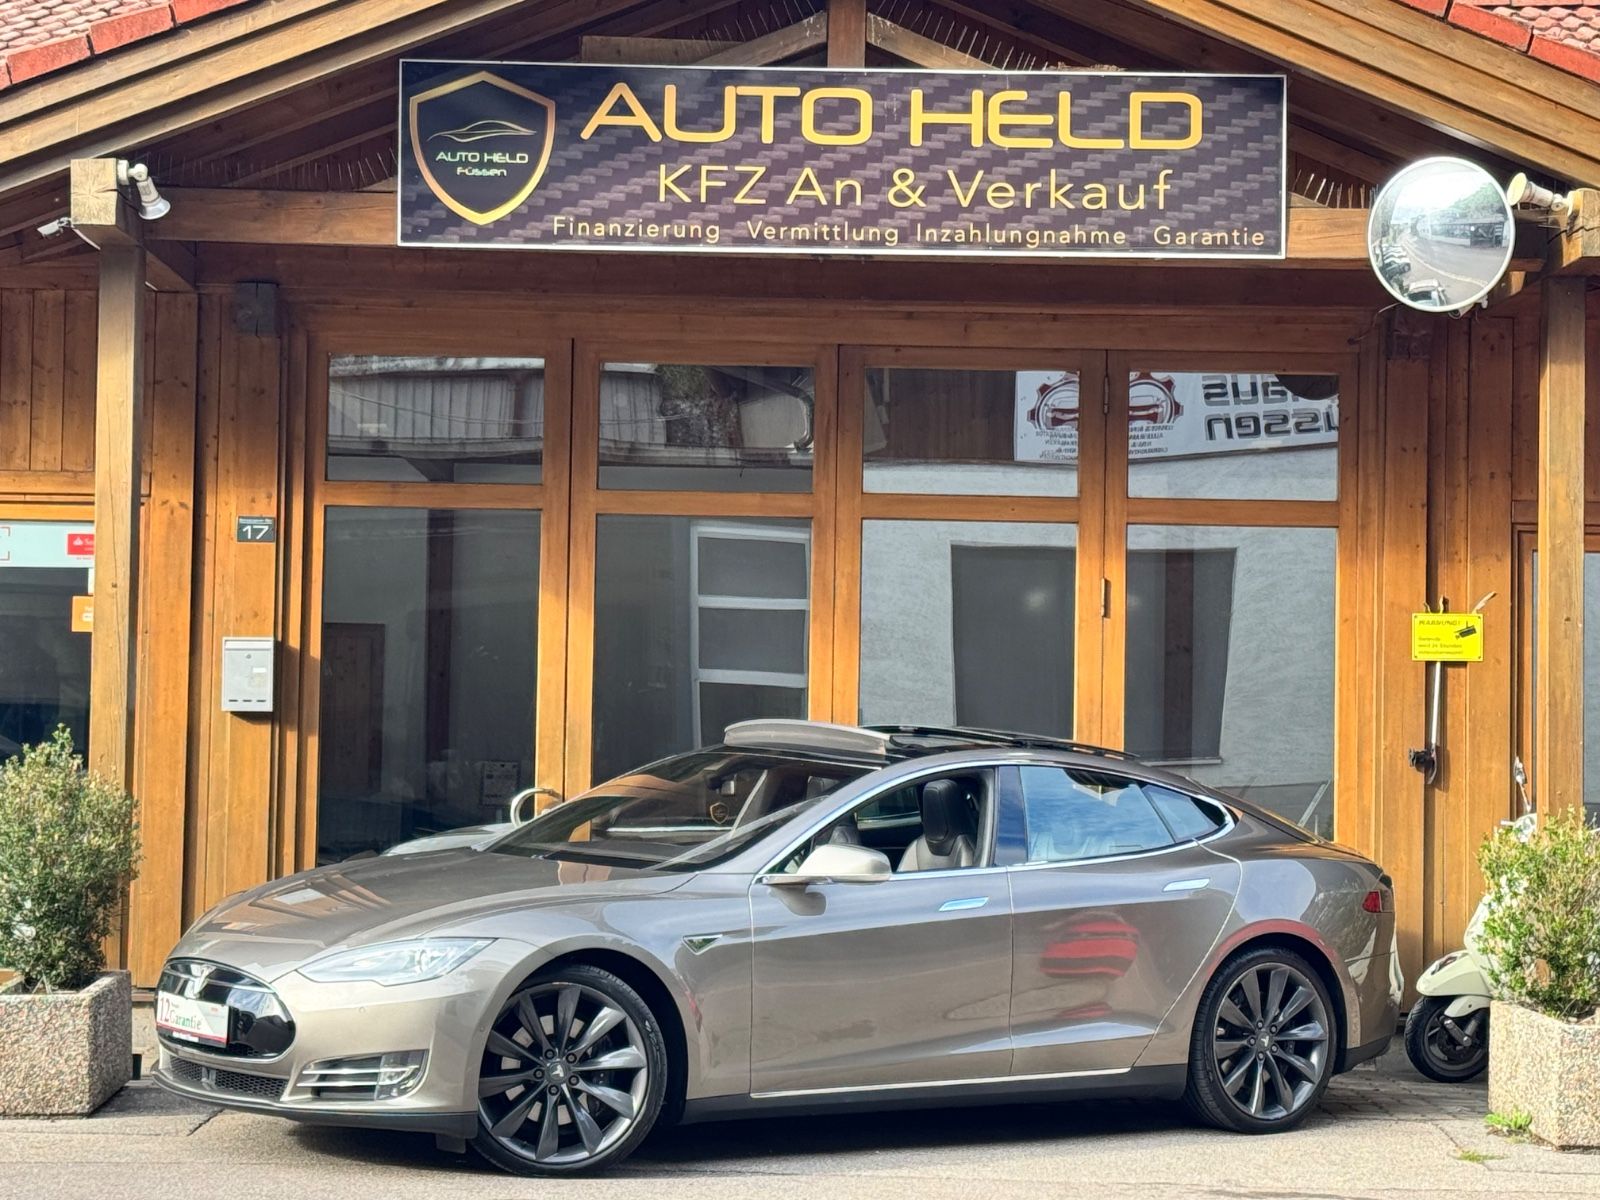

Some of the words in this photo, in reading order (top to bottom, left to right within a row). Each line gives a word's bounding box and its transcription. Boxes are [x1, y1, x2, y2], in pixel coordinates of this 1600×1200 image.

[580, 82, 874, 146] AUTO
[909, 88, 1203, 151] HELD
[435, 151, 481, 164] AUTO
[483, 151, 529, 165] HELD
[456, 166, 508, 177] Füssen
[659, 164, 767, 205] KFZ
[786, 166, 862, 206] An
[887, 167, 926, 209] &
[947, 168, 1173, 211] Verkauf
[552, 216, 720, 243] Finanzierung
[746, 220, 899, 247] Vermittlung
[916, 223, 1127, 249] Inzahlungnahme
[1153, 225, 1266, 247] Garantie
[242, 525, 269, 540] 17
